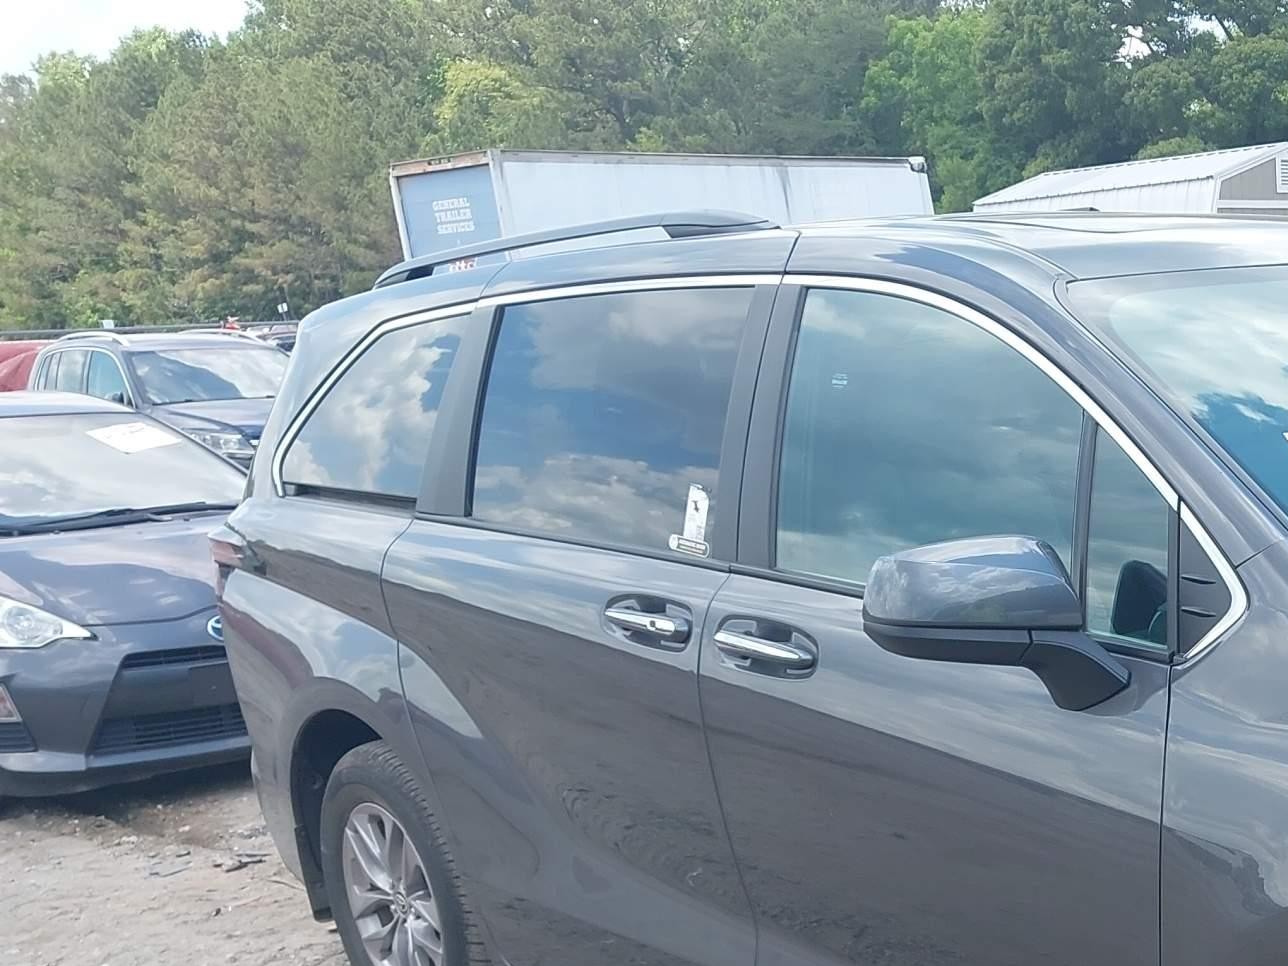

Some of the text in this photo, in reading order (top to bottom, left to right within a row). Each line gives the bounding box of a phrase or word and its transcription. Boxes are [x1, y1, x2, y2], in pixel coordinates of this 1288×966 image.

[433, 198, 470, 211] GENERAL
[435, 209, 472, 222] TRAILER
[437, 222, 475, 234] SERVICES
